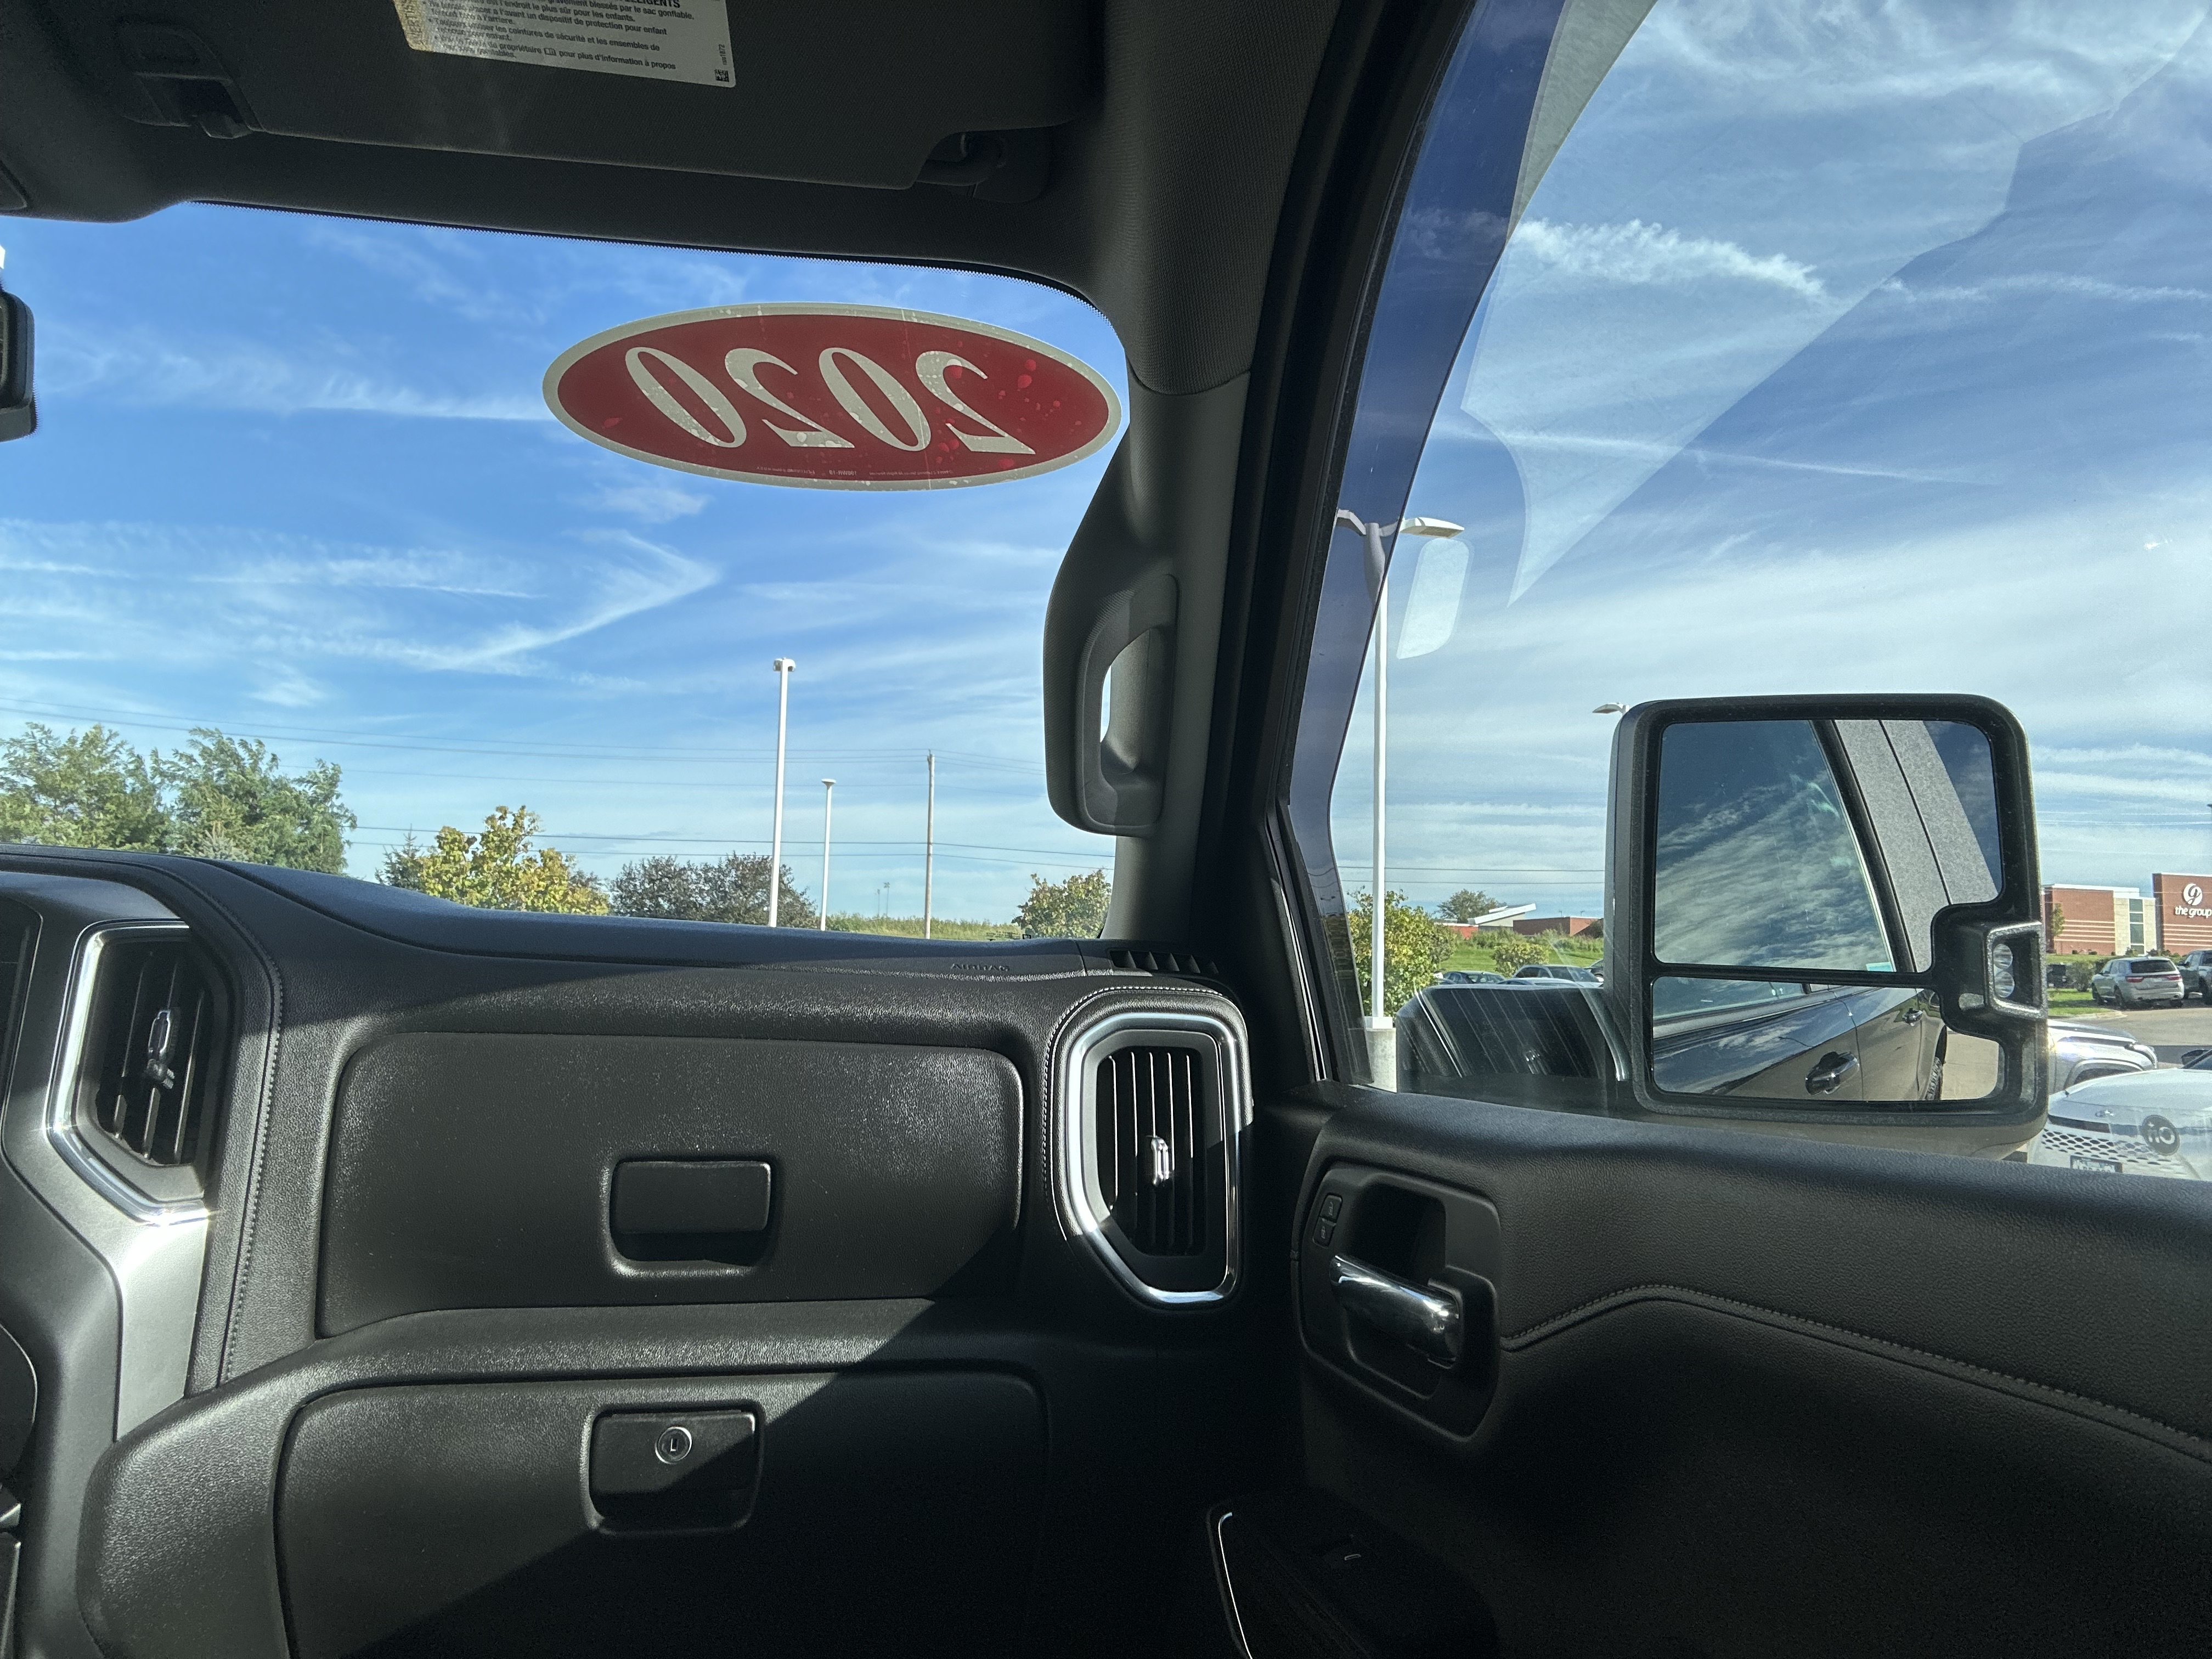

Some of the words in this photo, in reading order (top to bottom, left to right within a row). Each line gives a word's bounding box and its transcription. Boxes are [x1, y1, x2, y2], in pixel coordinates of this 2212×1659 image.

[606, 12, 636, 22] enfants.
[658, 9, 694, 20] gonflable.
[586, 20, 623, 30] protection
[644, 26, 668, 35] enfant
[609, 40, 649, 50] ensembles
[650, 43, 660, 51] de
[577, 52, 594, 60] plus
[651, 61, 676, 70] propos
[2175, 906, 2188, 915] the
[2189, 908, 2212, 918] group
